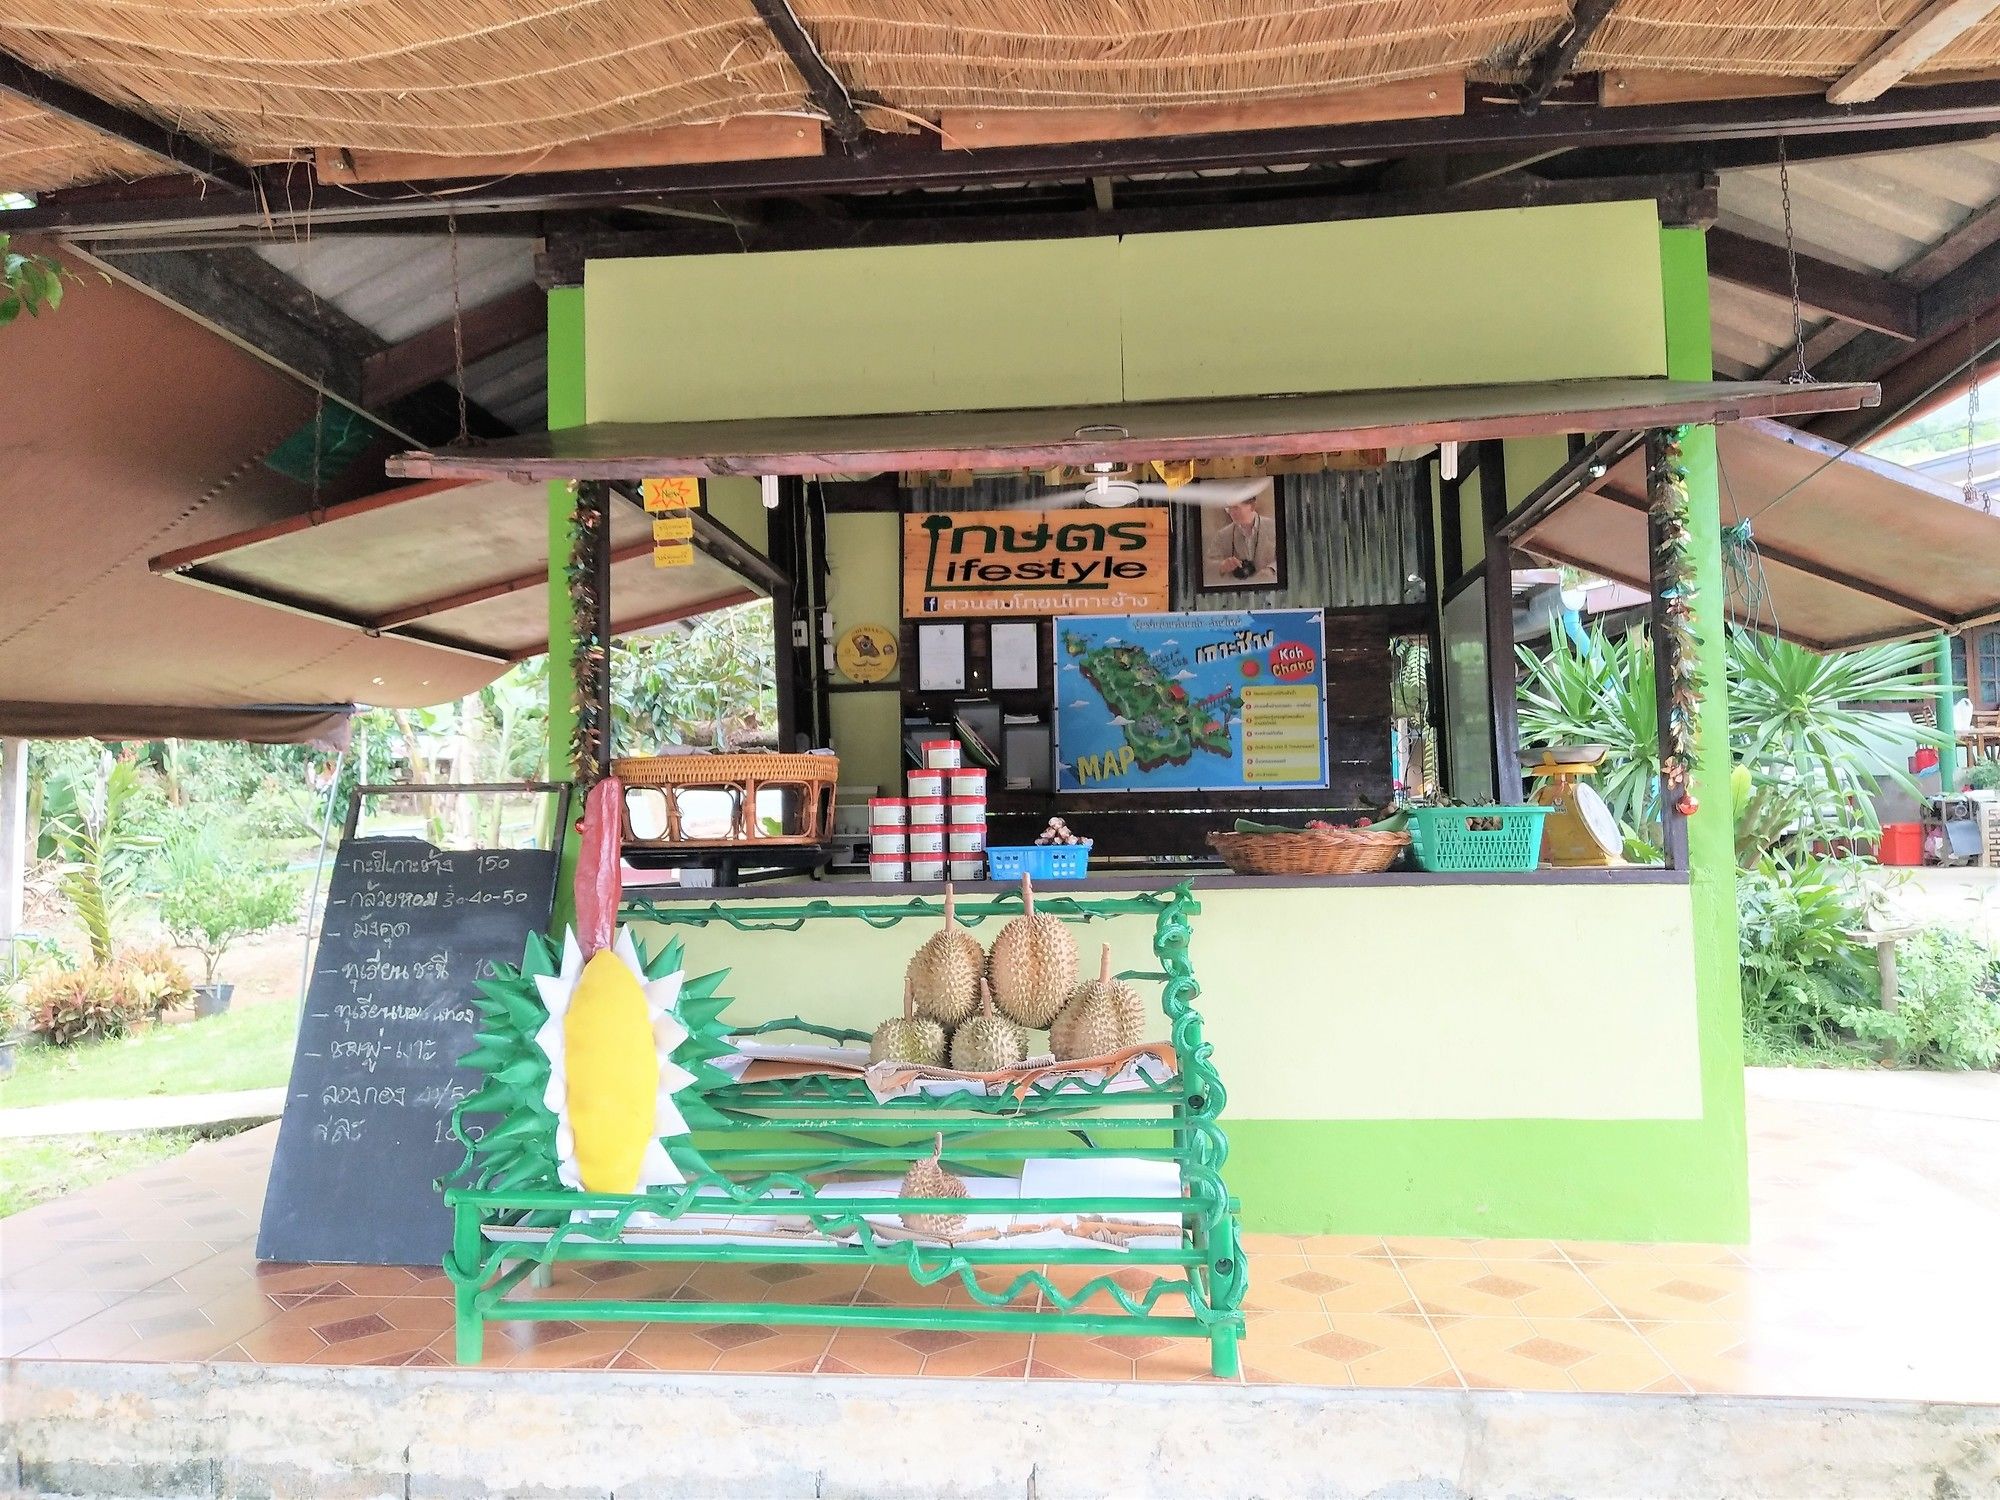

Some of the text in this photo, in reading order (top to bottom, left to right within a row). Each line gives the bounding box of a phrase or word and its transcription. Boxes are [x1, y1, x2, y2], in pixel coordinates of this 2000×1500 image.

[921, 515, 1149, 556] เกษตร
[1195, 629, 1275, 664] เกาะช้าง
[1279, 646, 1304, 660] Koh
[1272, 659, 1315, 677] Chang
[1076, 745, 1135, 785] MAP
[476, 855, 510, 875] 150
[475, 957, 518, 981] 10
